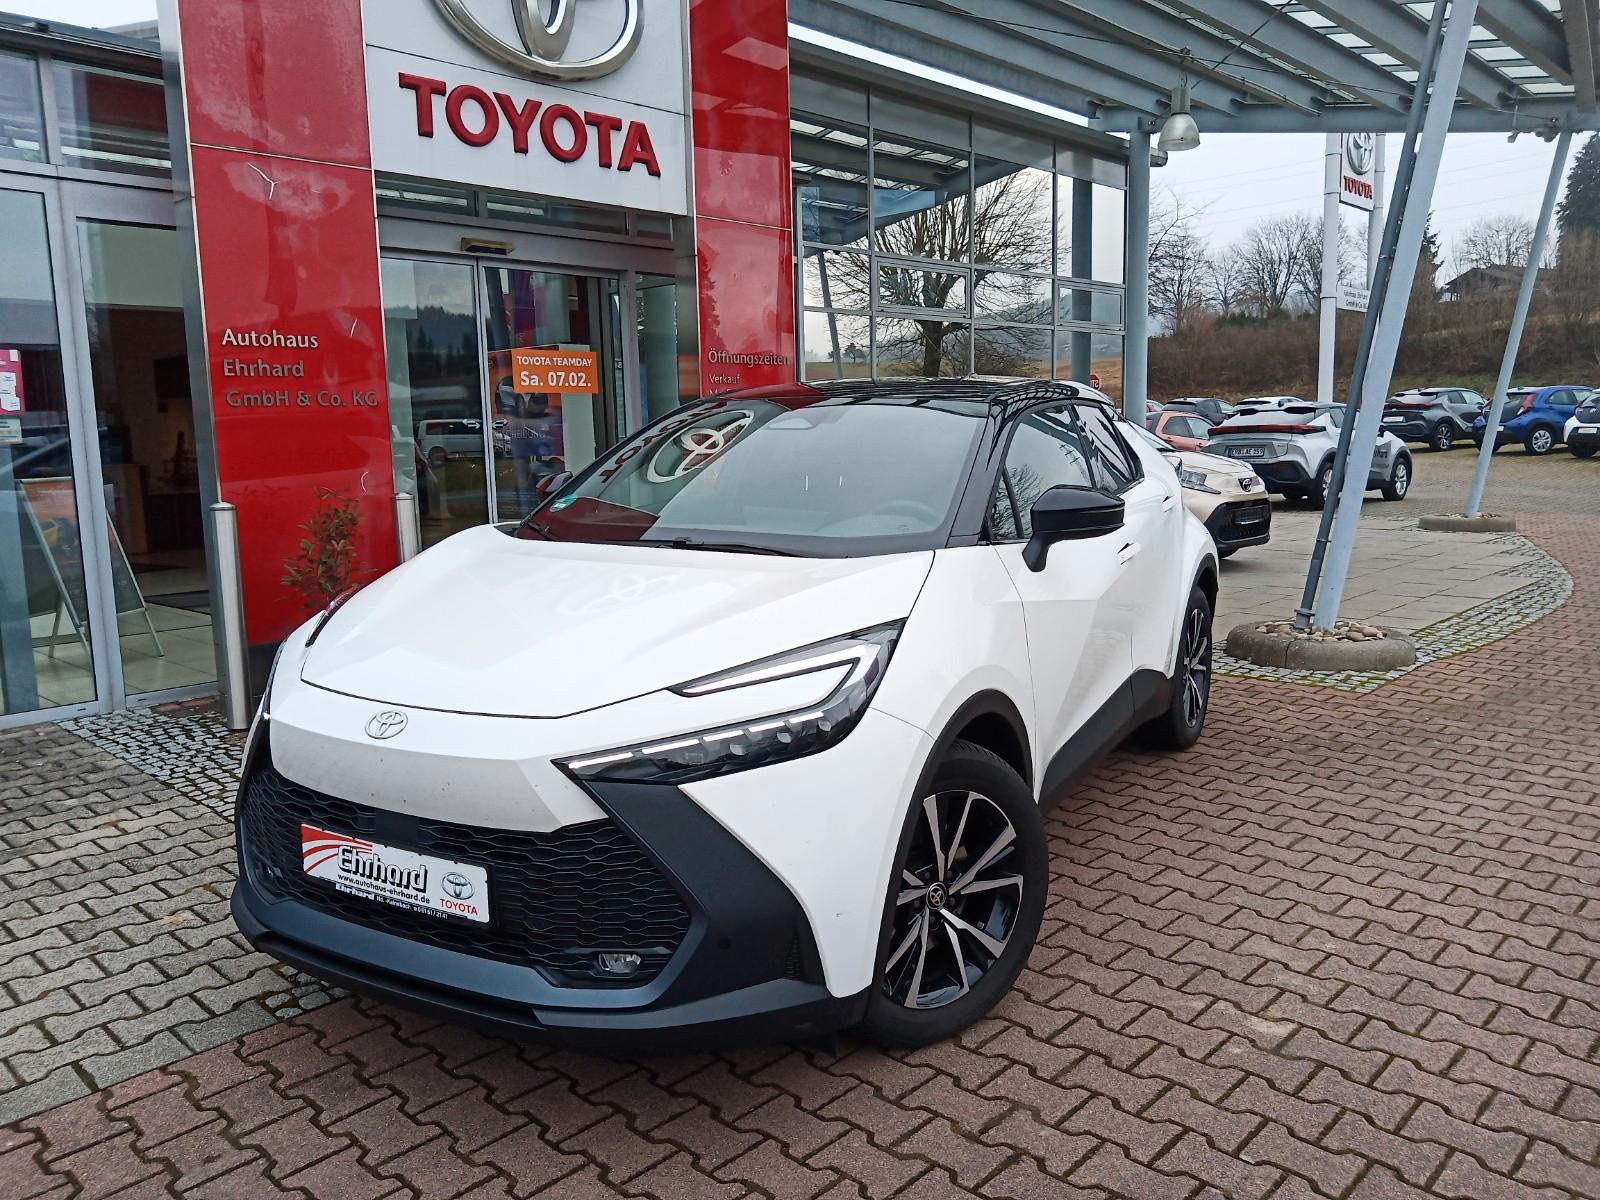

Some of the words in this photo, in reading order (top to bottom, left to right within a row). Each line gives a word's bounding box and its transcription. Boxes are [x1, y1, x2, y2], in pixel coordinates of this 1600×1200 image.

[398, 71, 661, 178] TOYOTA
[1343, 175, 1373, 200] TOYOTA
[222, 328, 319, 348] Autohaus
[516, 356, 551, 366] TOYOTA
[552, 357, 593, 367] TEAMDAY
[708, 347, 789, 368] Öffnungszeiten
[223, 359, 304, 377] Ehrhard
[520, 371, 544, 386] Sa.
[547, 371, 592, 387] 07.02.
[709, 374, 740, 384] Verkauf
[226, 390, 289, 407] GmbH
[296, 391, 311, 406] &
[317, 391, 346, 407] Co.
[352, 391, 378, 406] KG
[337, 845, 428, 893] Ehrhard
[338, 874, 431, 904] www.autohaus-ehrhard.de
[440, 898, 478, 916] TOYOTA
